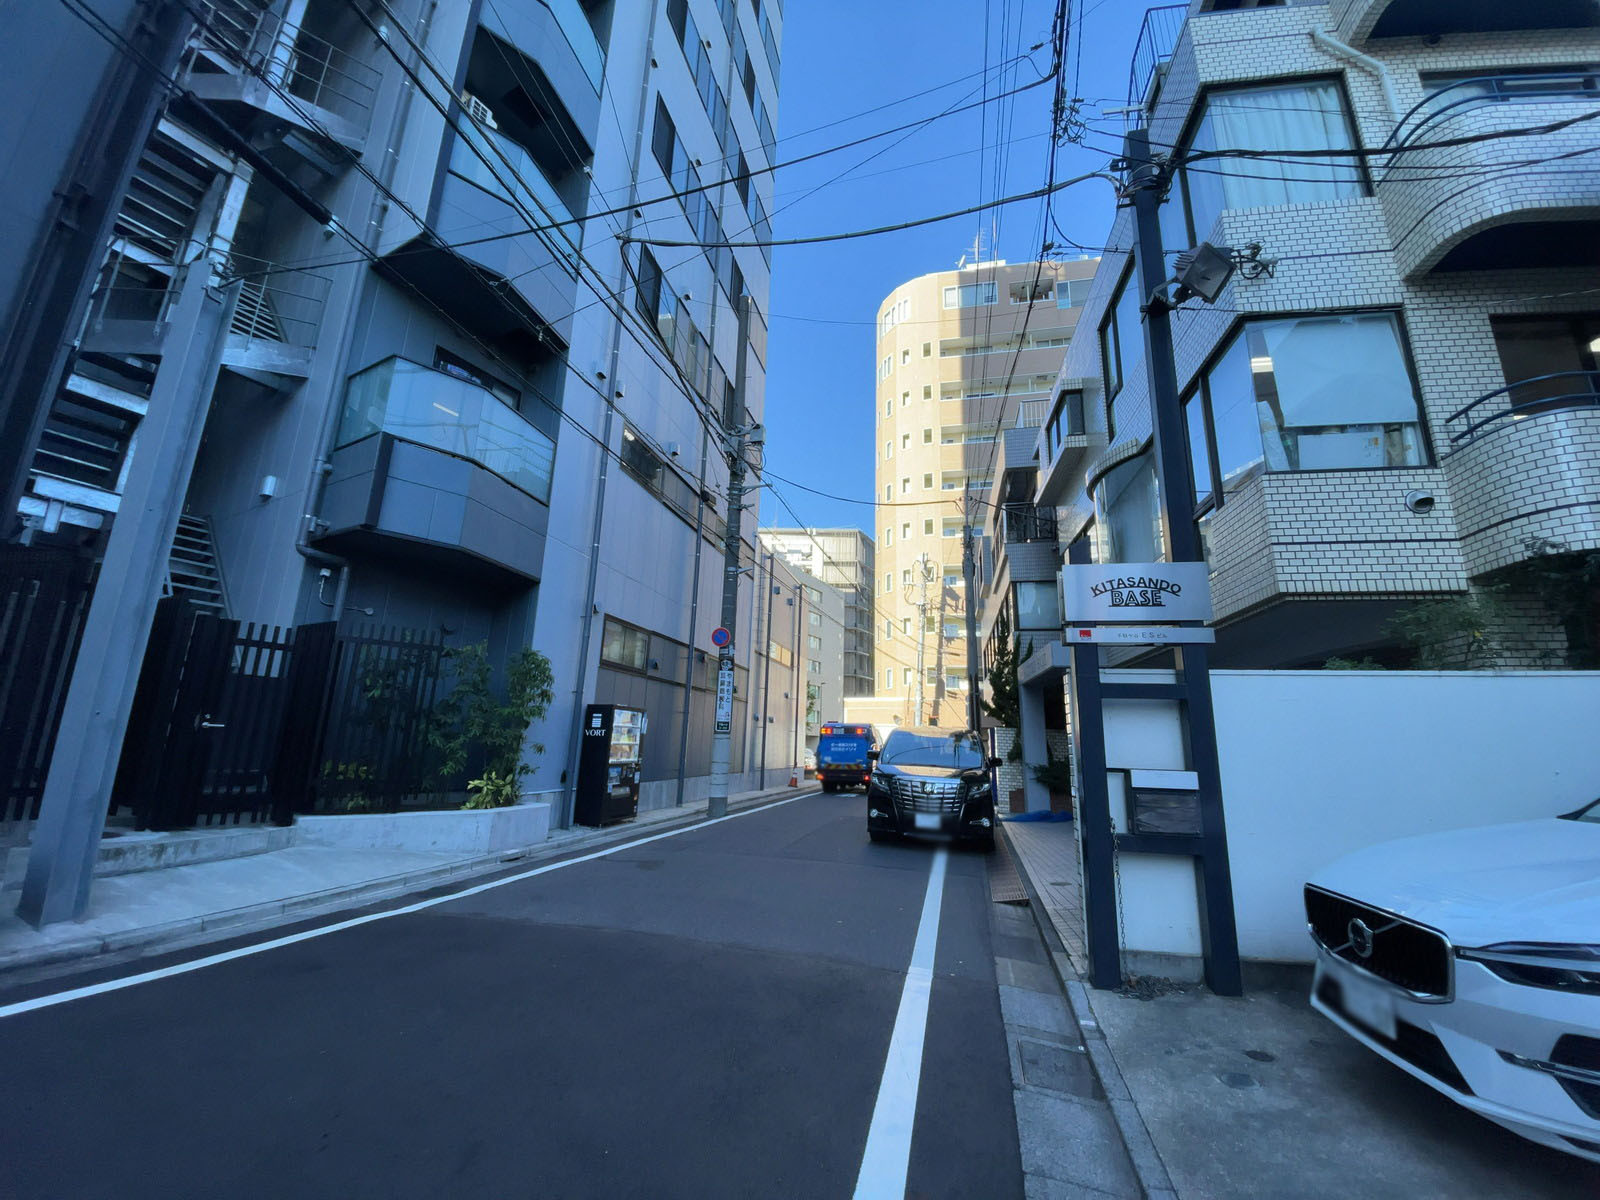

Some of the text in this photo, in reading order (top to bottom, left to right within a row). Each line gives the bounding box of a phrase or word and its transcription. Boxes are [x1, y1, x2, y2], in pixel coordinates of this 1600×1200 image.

[1090, 577, 1182, 596] KITASANDO
[1111, 590, 1163, 606] BASE
[725, 672, 733, 704] やまもと
